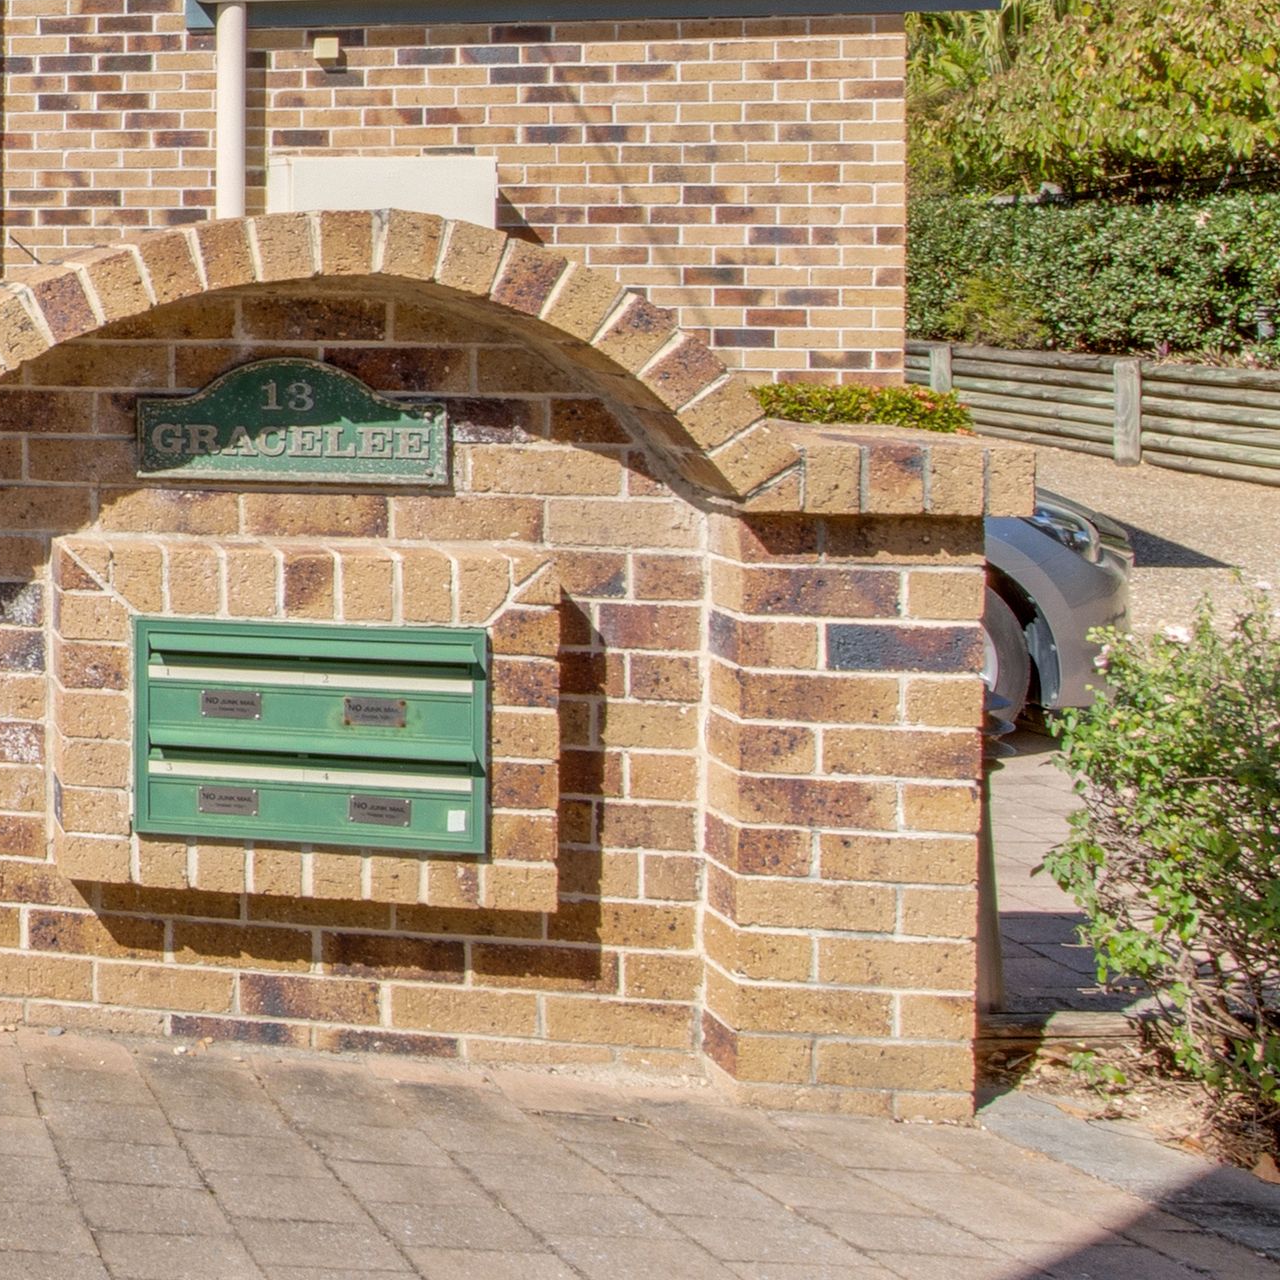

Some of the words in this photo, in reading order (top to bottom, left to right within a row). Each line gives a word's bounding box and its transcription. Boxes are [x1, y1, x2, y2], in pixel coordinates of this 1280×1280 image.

[260, 380, 315, 412] 13
[151, 423, 431, 460] GRACELEE
[205, 696, 219, 704] NO
[348, 703, 362, 712] NO
[202, 792, 216, 800] NO
[353, 801, 368, 810] NO
